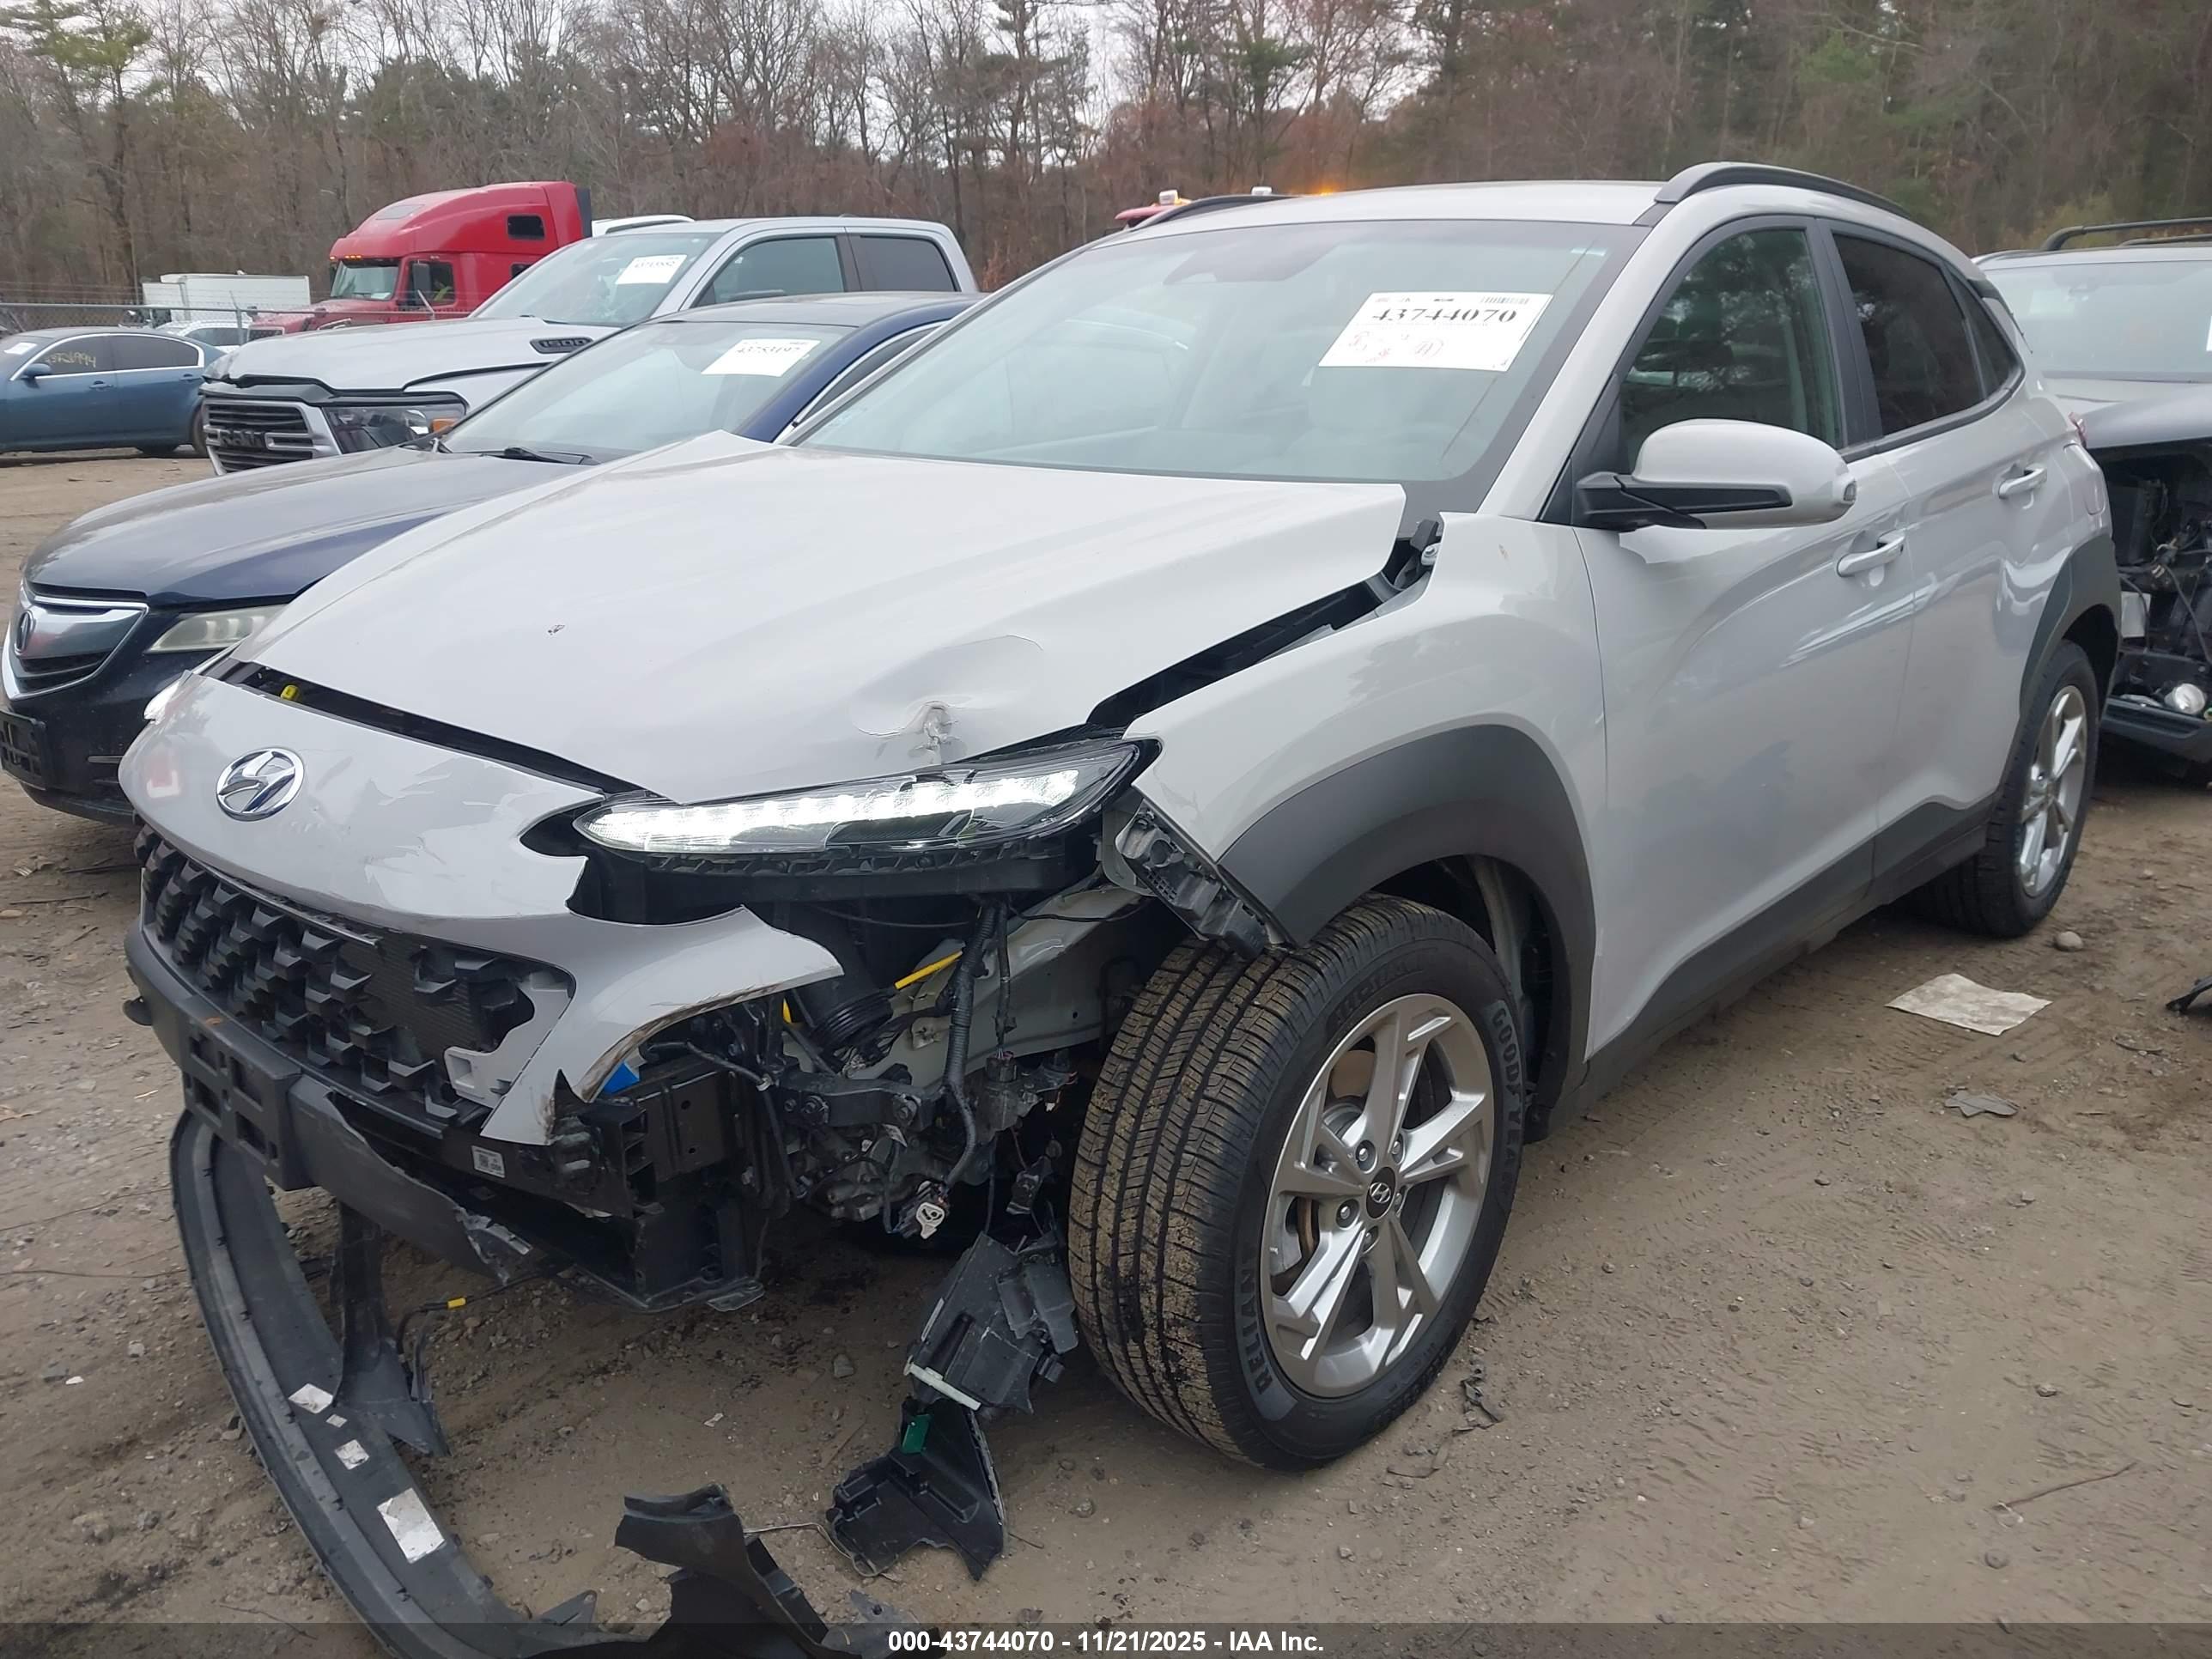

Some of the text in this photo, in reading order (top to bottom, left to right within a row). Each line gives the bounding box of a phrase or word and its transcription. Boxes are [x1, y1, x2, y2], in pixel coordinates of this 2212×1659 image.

[1372, 308, 1517, 322] 43744070
[542, 338, 587, 347] 1500
[219, 429, 263, 448] RAM
